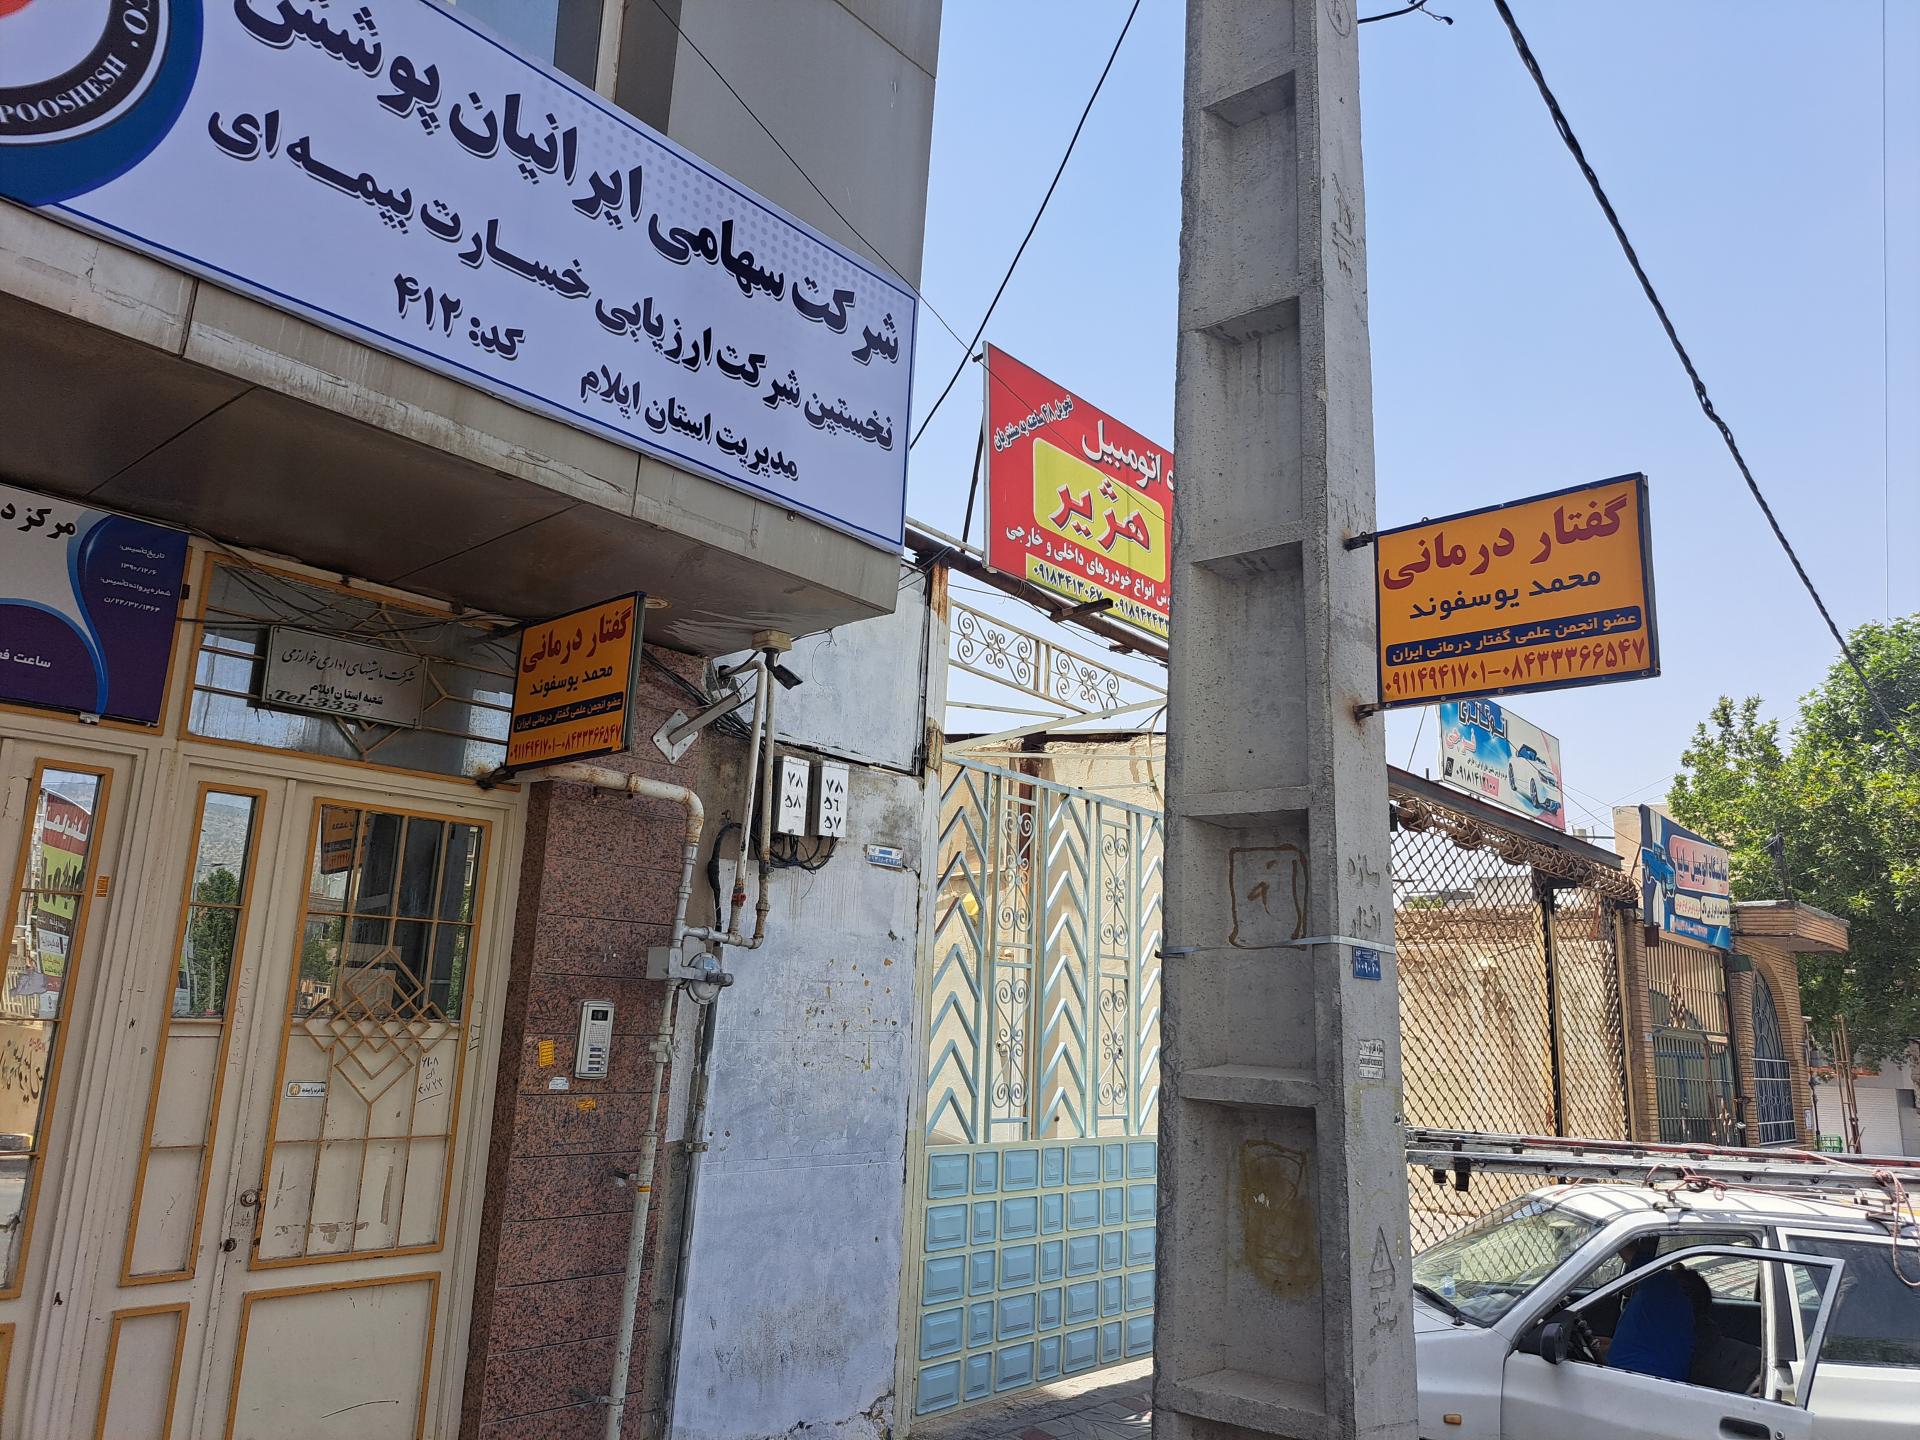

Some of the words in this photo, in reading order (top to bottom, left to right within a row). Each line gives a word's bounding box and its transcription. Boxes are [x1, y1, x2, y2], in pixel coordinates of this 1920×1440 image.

[233, 0, 443, 136] پوشش
[0, 52, 128, 124] POOSHESH
[208, 109, 281, 161] ای
[449, 91, 644, 232] ایرانیان
[286, 135, 414, 235] بیمه
[420, 199, 591, 299] خسارت
[647, 213, 786, 300] سهامی
[394, 272, 463, 337] ۴۱۲
[791, 276, 900, 362] شرکت
[468, 316, 525, 359] کد:
[594, 297, 712, 372] ارزیابی
[580, 364, 641, 420] ایلام
[716, 347, 802, 409] شرکت
[644, 397, 712, 440] استان
[803, 395, 895, 451] نخستین
[715, 427, 798, 481] مدیریت
[1081, 418, 1162, 490] اتومبیل
[16, 506, 77, 540] مرکز
[1048, 477, 1152, 553] هژیر
[1529, 493, 1629, 565] گفتار
[1005, 525, 1044, 548] خارجی
[1045, 541, 1052, 557] و
[1053, 542, 1085, 566] داخلی
[1383, 527, 1515, 590] درمانی
[1086, 557, 1132, 591] خودروهای
[1133, 577, 1156, 601] انواع
[1528, 569, 1601, 597] محمد
[1408, 587, 1520, 621] یوسفوند
[586, 606, 633, 657] گفتار
[1475, 629, 1512, 651] گفتار
[1515, 626, 1551, 645] علمی
[1554, 617, 1598, 639] انجمن
[1602, 614, 1637, 632] عضو
[13, 652, 52, 669] ساعت
[281, 648, 318, 665] خوارزمی
[316, 656, 347, 670] اداری
[522, 627, 583, 674] درمانی
[1391, 644, 1424, 664] ایران
[1426, 638, 1472, 658] درمانی
[309, 683, 335, 698] ایلام
[384, 664, 420, 687] شرکت
[529, 674, 580, 698] یوسفوند
[581, 664, 613, 684] محمد
[333, 688, 363, 701] استان
[363, 693, 384, 706] شعبه
[787, 771, 804, 789] ۷۸
[826, 779, 844, 794] ۷۸
[785, 795, 801, 809] ۵۸
[824, 816, 842, 830] ۵۷
